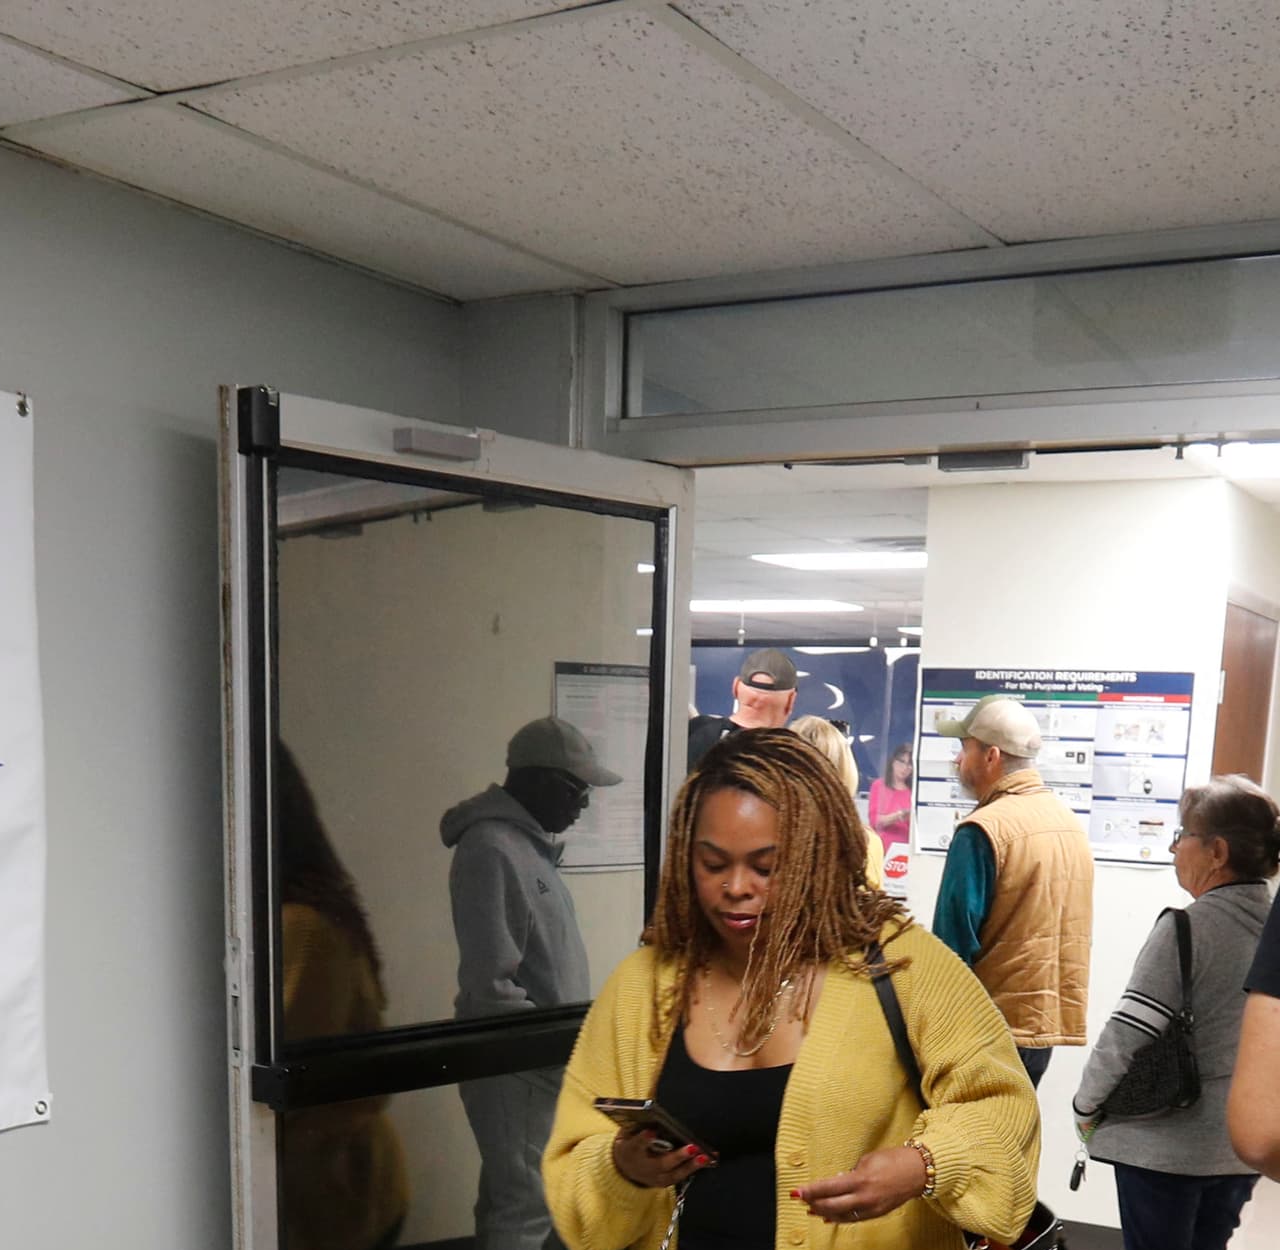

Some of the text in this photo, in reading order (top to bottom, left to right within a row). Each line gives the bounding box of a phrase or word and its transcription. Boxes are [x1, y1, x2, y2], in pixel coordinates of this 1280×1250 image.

[975, 671, 1138, 683] IDENTIFICATION REQUIREMENTS
[1004, 682, 1019, 690] For
[1019, 682, 1033, 690] the
[1034, 683, 1067, 692] Purpose
[1067, 683, 1077, 691] of
[1076, 683, 1104, 693] Voting
